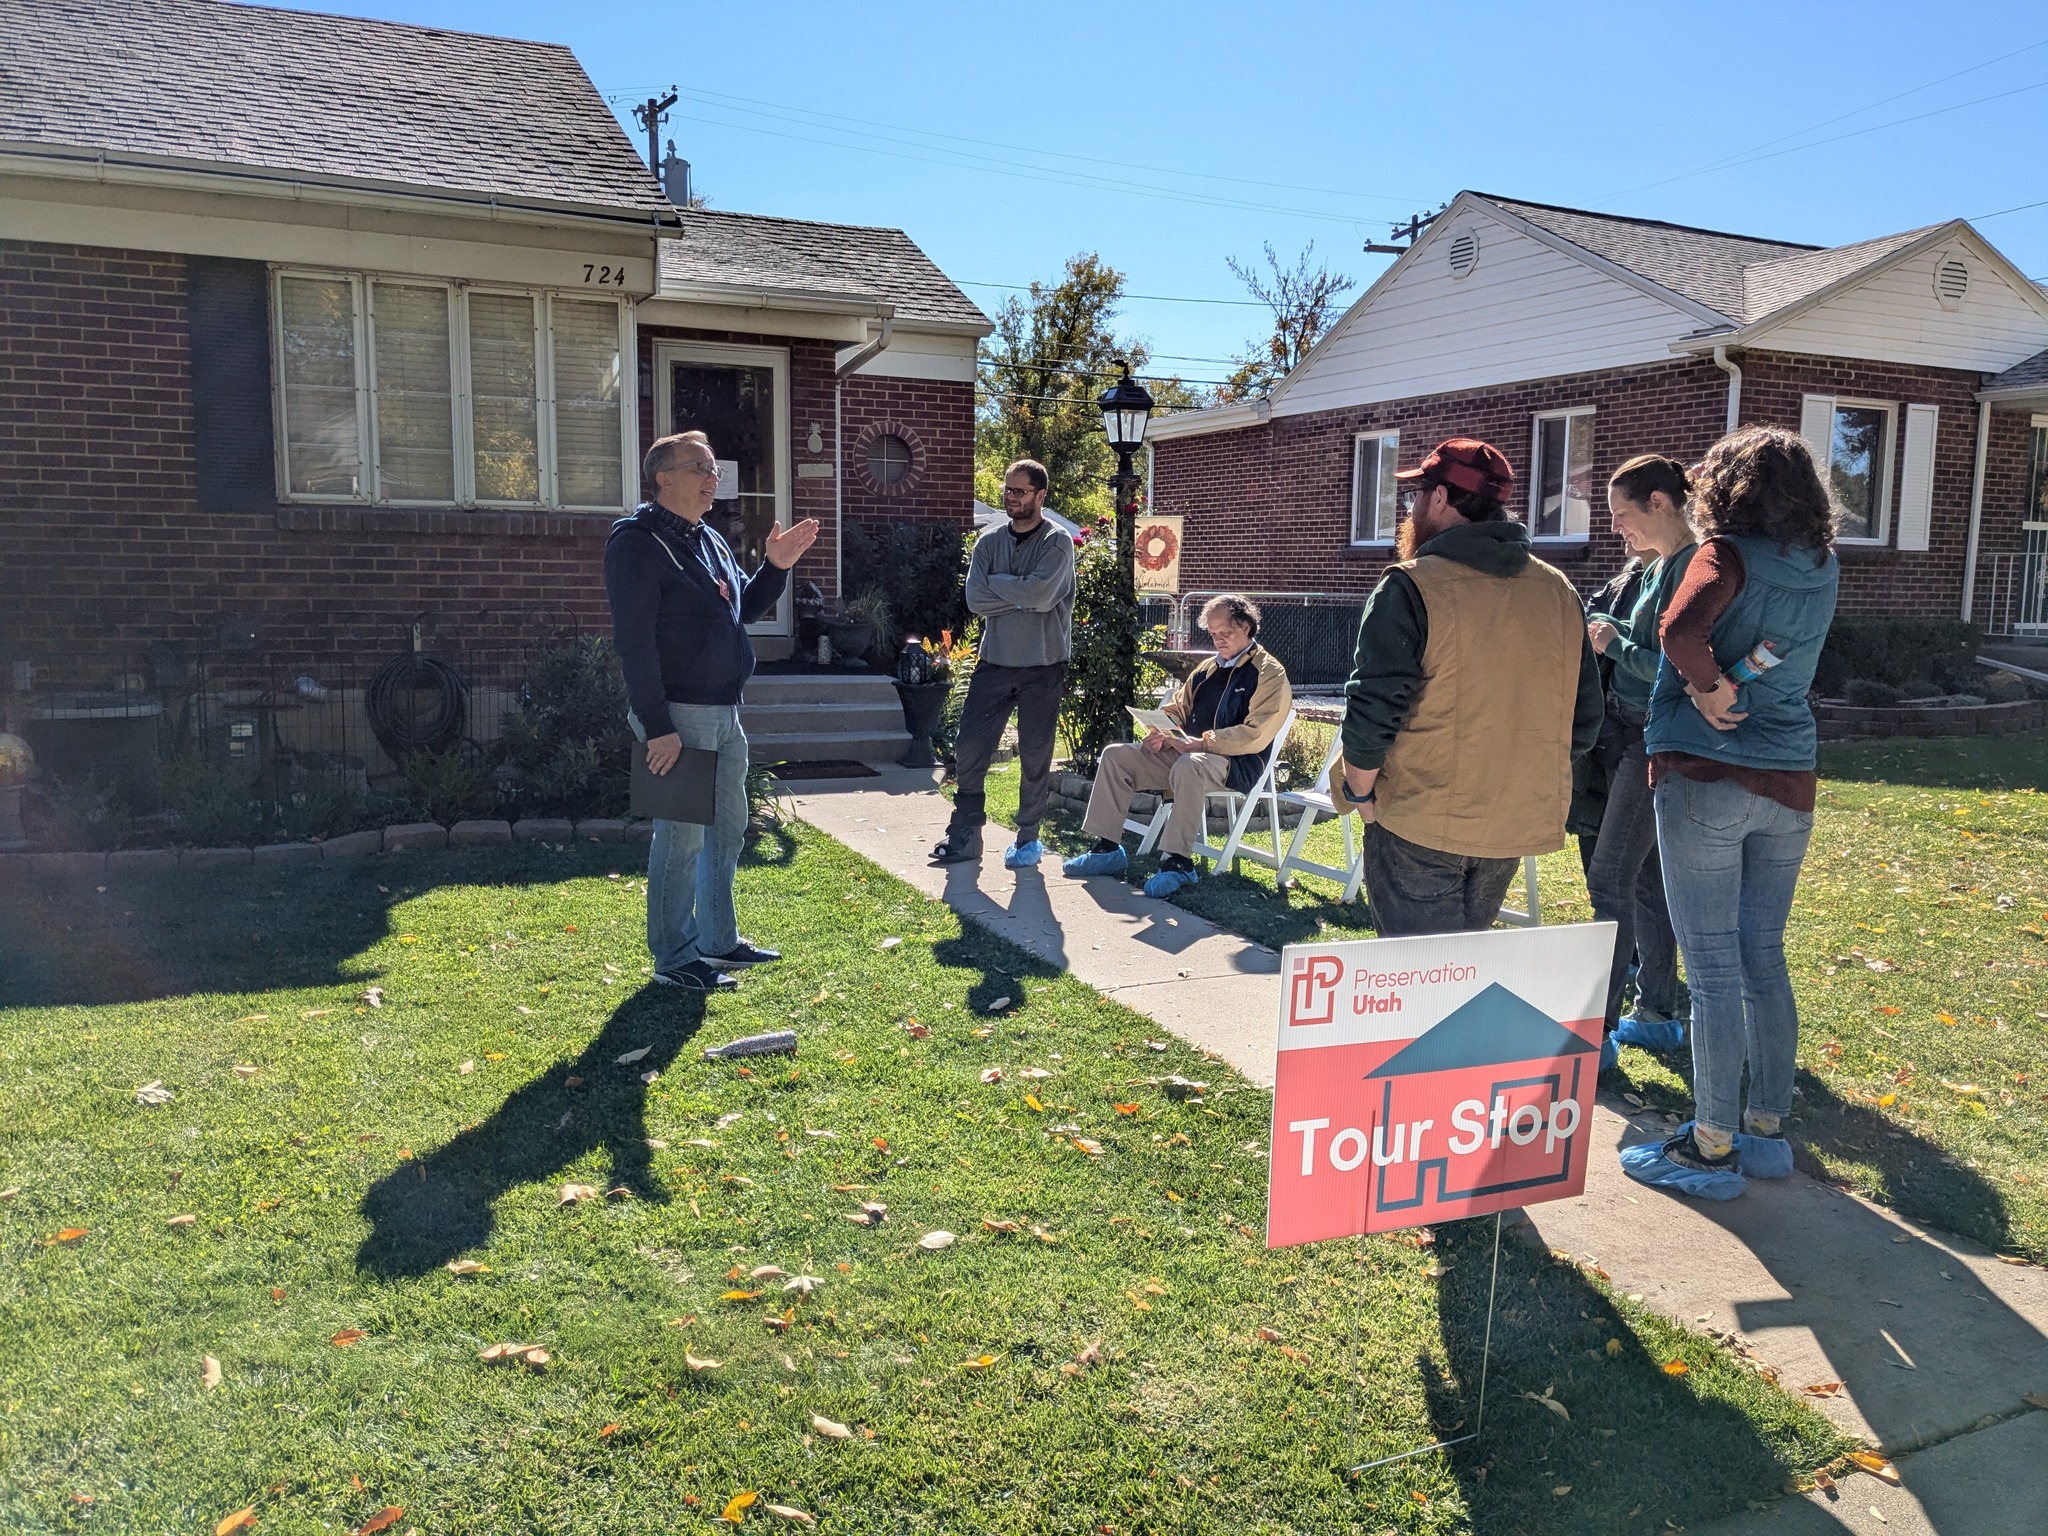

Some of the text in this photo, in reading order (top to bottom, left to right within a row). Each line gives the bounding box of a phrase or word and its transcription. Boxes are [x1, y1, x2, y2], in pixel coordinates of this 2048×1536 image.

[583, 264, 625, 287] 724
[1354, 961, 1476, 990] Preservation
[1352, 991, 1402, 1015] Utah
[1289, 1095, 1581, 1176] Tour Stop
